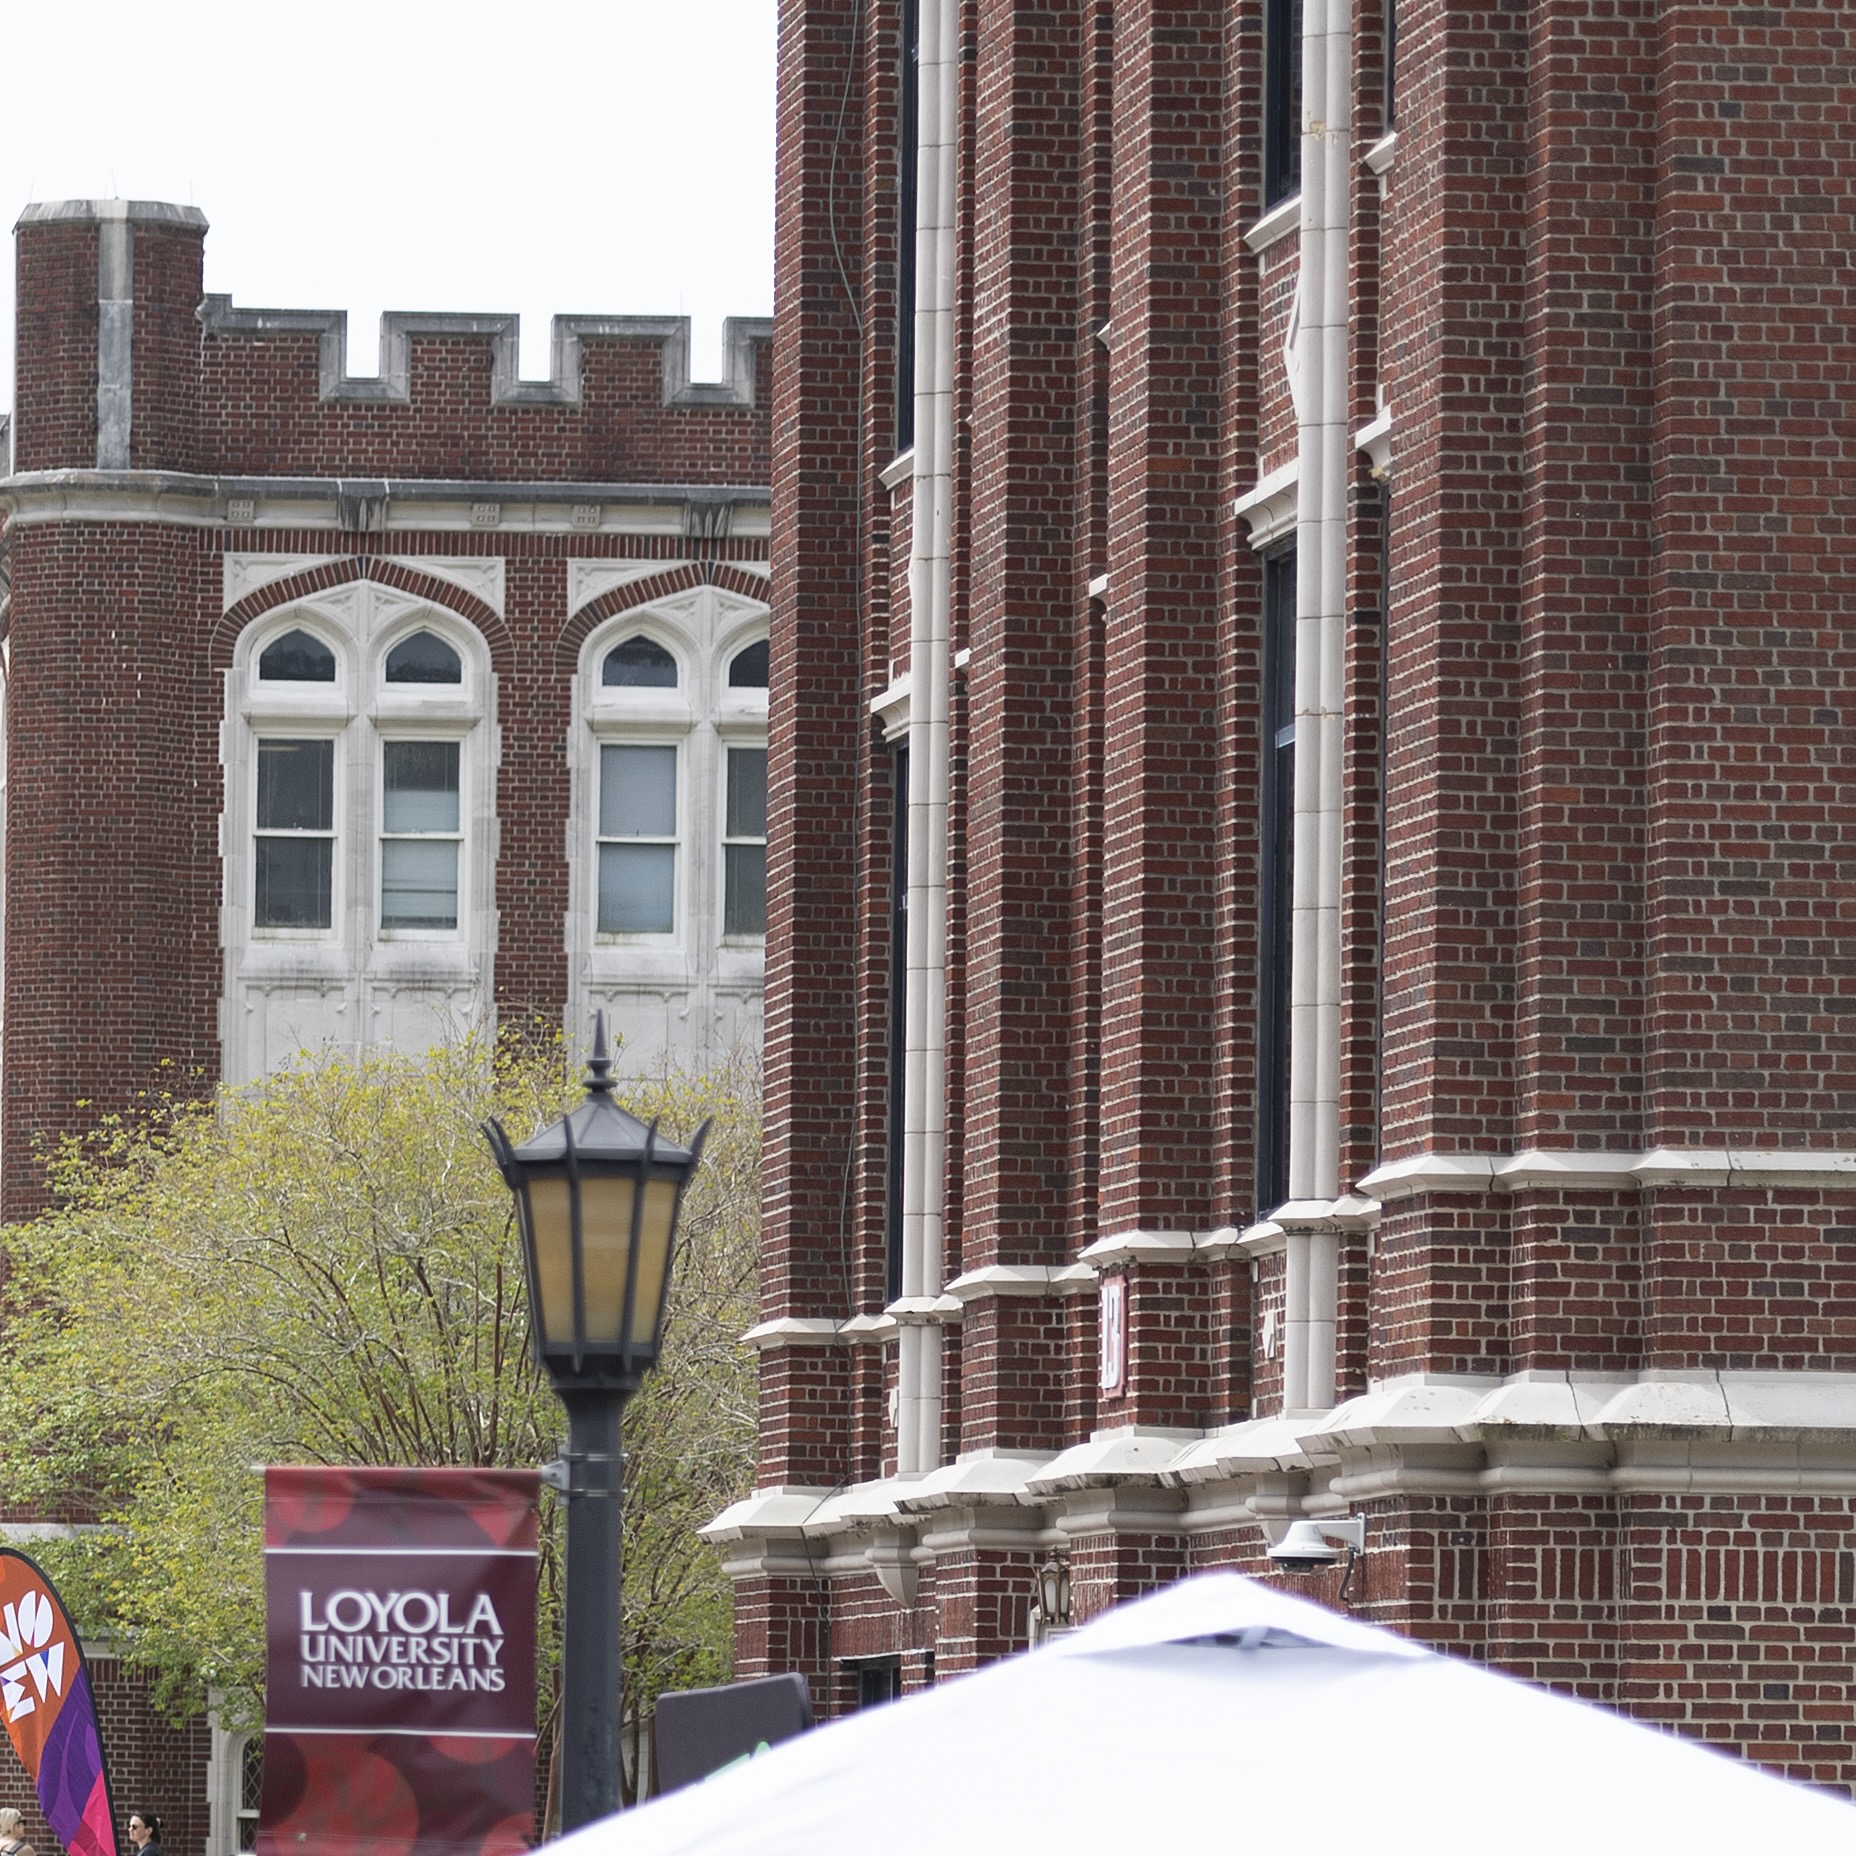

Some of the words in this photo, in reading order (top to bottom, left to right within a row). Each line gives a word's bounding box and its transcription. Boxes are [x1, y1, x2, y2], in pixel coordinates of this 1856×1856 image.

[299, 1590, 502, 1635] LOYOLA
[300, 1635, 505, 1666] UNIVERSITY
[302, 1663, 372, 1690] NEW
[372, 1665, 506, 1694] ORLEANS
